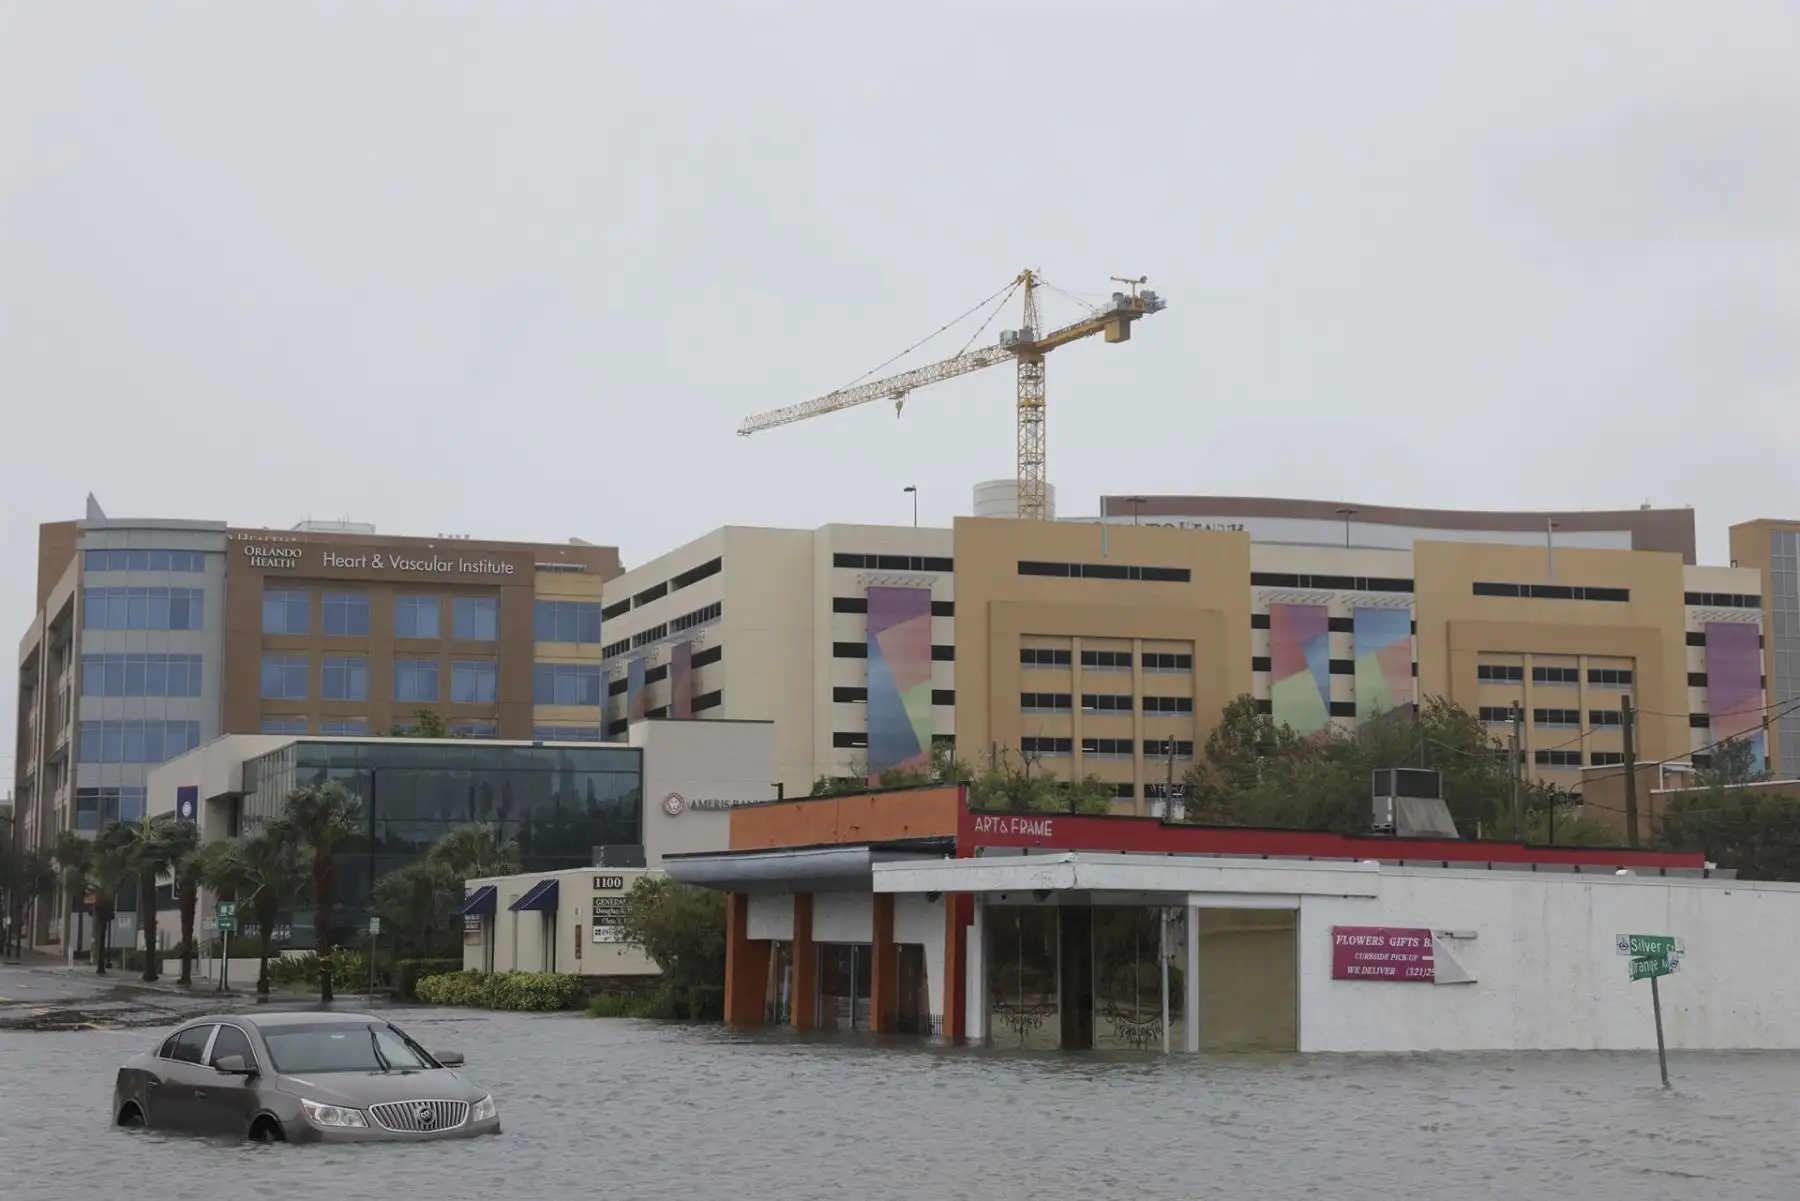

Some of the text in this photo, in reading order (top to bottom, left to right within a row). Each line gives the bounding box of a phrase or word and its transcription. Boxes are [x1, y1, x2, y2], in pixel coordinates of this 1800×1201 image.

[244, 545, 302, 558] ORLANDO
[250, 556, 296, 568] HEALTH
[323, 551, 514, 574] Heart & Vascular Institute
[690, 799, 730, 810] AMERIS
[1011, 818, 1053, 837] FRAME
[595, 877, 621, 888] 1100
[1336, 934, 1385, 946] FLOWERS
[1389, 936, 1420, 947] GIFTS
[1631, 938, 1662, 953] Silver
[1355, 952, 1389, 961] CURBSIDE
[1347, 965, 1360, 974] WE
[1361, 966, 1396, 975] DELIVER
[1632, 959, 1658, 975] Orange
